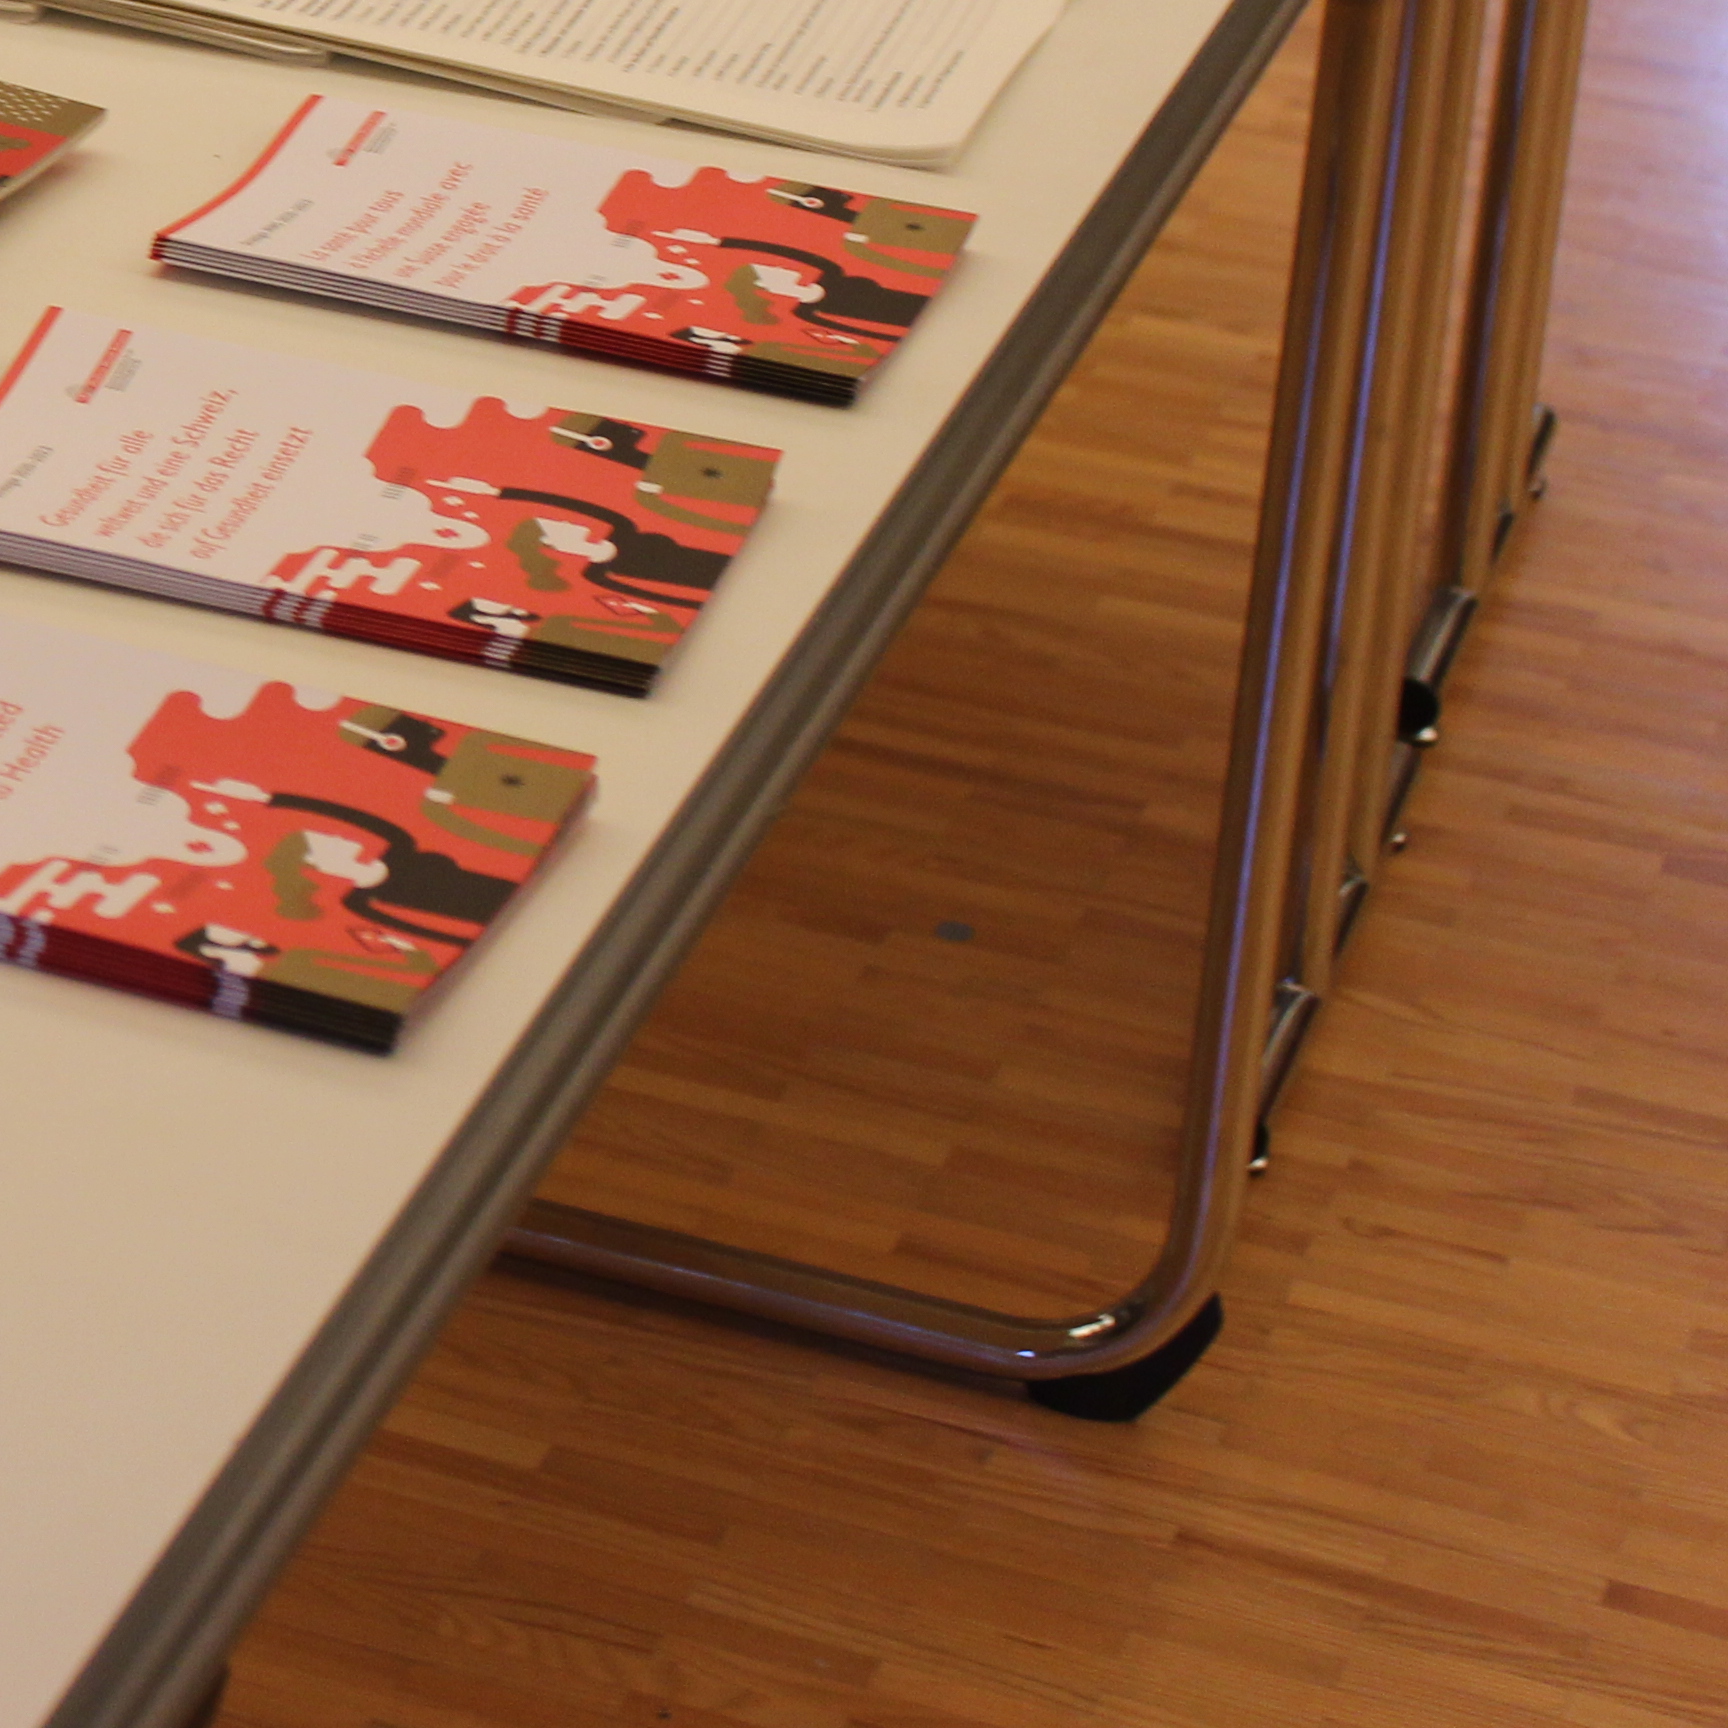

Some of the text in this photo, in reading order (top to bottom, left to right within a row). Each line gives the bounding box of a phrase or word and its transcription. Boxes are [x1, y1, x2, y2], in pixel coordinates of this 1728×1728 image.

[439, 163, 472, 191] avec
[170, 389, 238, 448] Schweiz,
[120, 429, 153, 455] alle
[207, 428, 259, 469] Recht
[261, 426, 313, 481] einsetzt
[156, 451, 191, 477] eine
[136, 476, 169, 500] und
[193, 470, 230, 493] das
